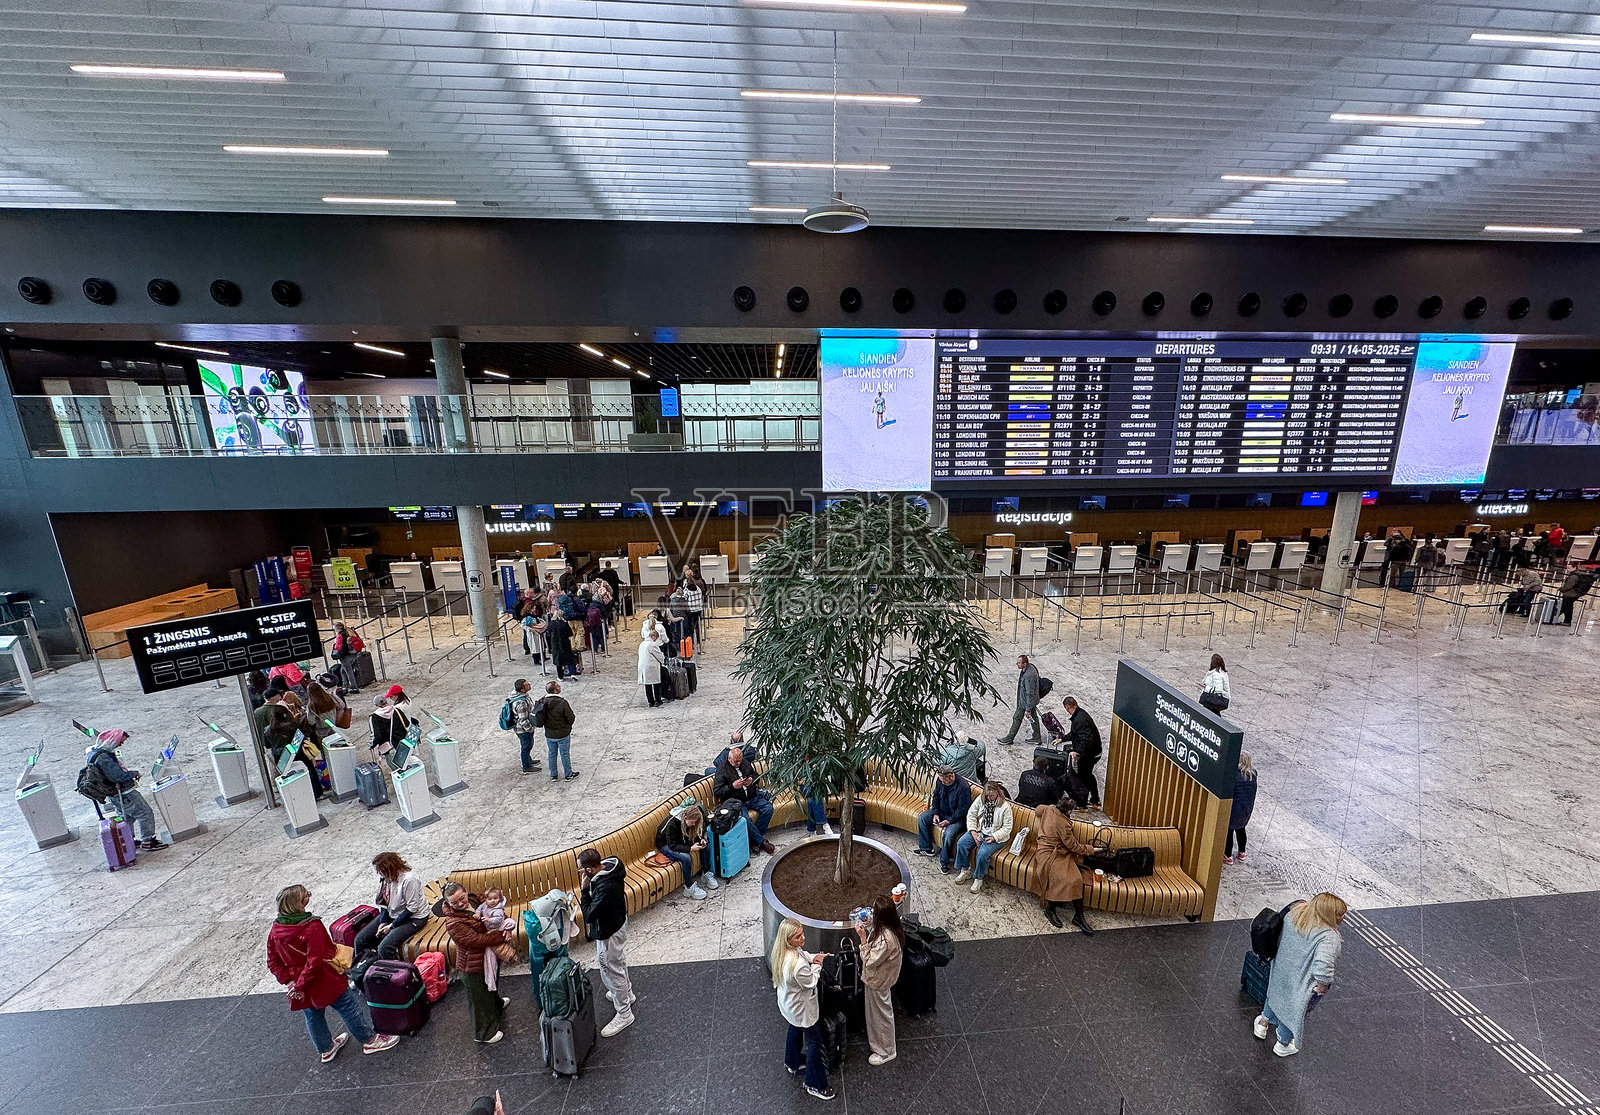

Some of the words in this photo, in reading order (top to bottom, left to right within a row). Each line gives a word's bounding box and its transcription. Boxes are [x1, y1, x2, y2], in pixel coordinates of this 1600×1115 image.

[1155, 344, 1216, 355] DEPARTURES
[1310, 344, 1337, 355] 09:31
[1347, 344, 1400, 355] 14-05-2025
[859, 352, 898, 364] ŠIANDIEN
[1448, 360, 1480, 369] ŠIANDIEN
[842, 367, 881, 379] KELIONĖS
[882, 368, 914, 379] KRYPTIS
[1432, 372, 1464, 382] KELIONĖS
[1464, 373, 1490, 382] KRYPTIS
[860, 382, 874, 392] JAU
[876, 382, 897, 392] AIŠKI
[1442, 386, 1456, 395] JAU
[1457, 385, 1474, 395] AIŠKI
[270, 612, 297, 624] STEP
[258, 626, 274, 636] Tag
[274, 624, 291, 633] your
[292, 620, 307, 630] bag
[143, 636, 151, 646] 1
[154, 626, 211, 644] ŽINGSNIS
[146, 640, 197, 656] Pažymėkite
[198, 637, 218, 646] savo
[218, 631, 248, 643] bagažą
[1156, 694, 1191, 726] Specialioji
[1190, 718, 1222, 748] pagalba
[1154, 708, 1179, 733] Special
[1178, 726, 1219, 762] Assistance
